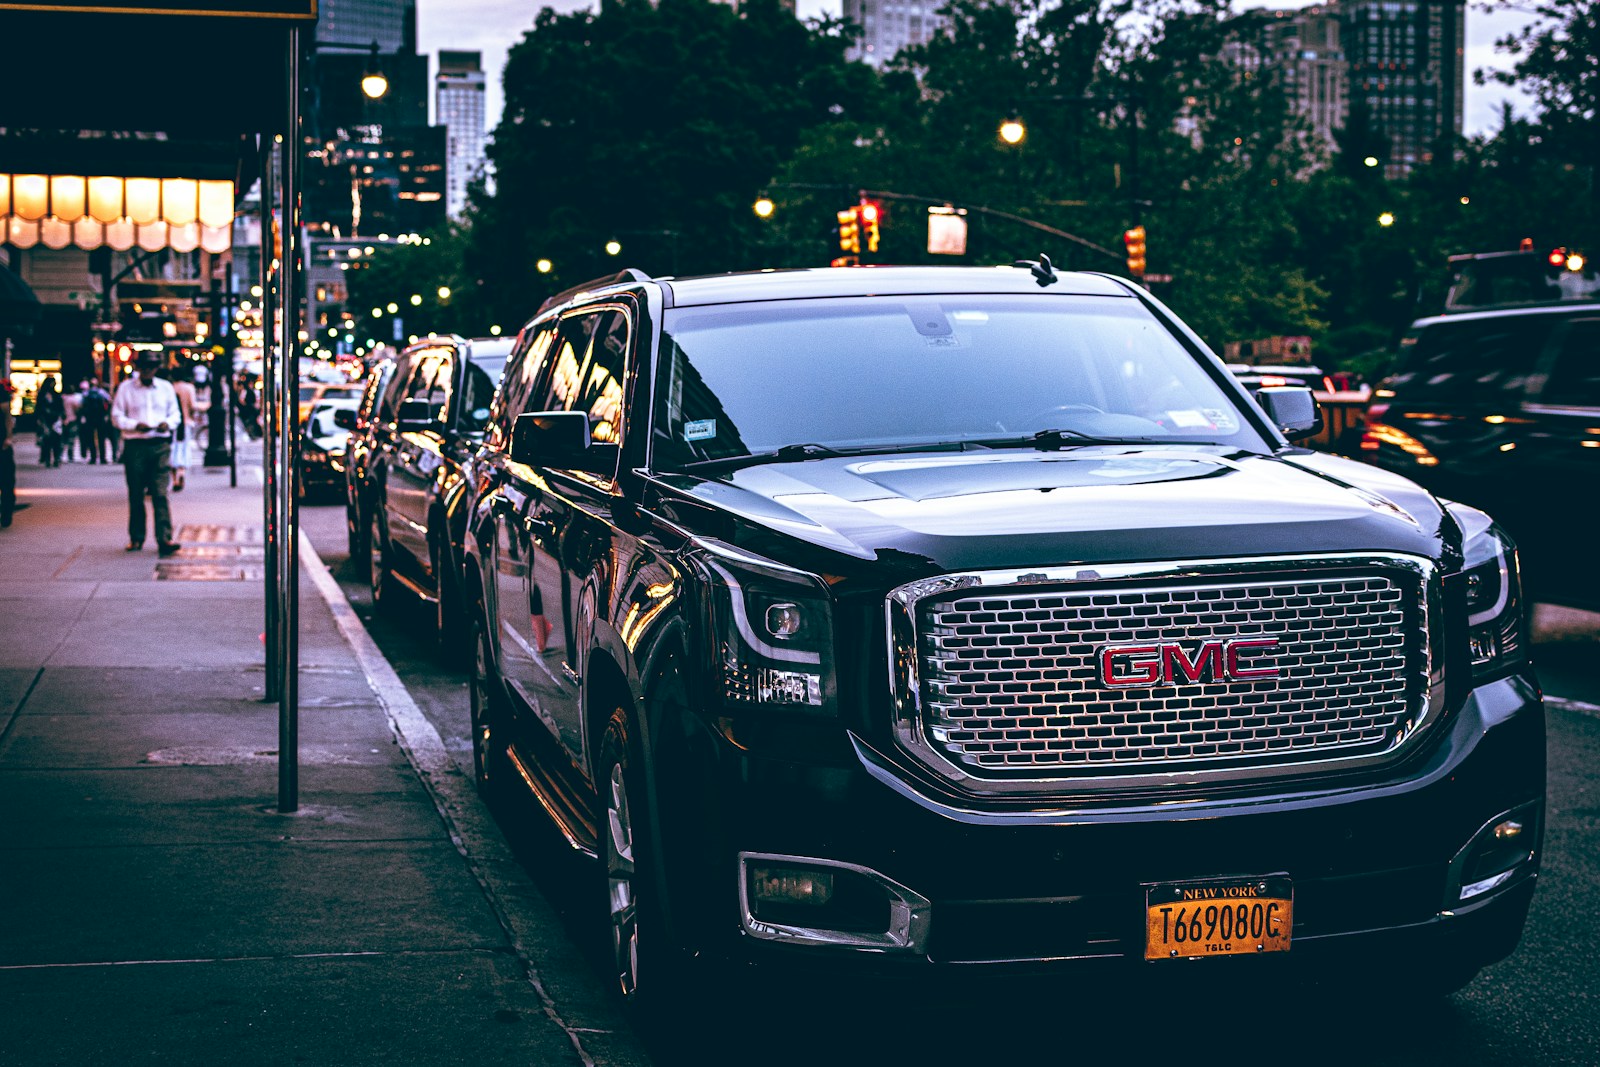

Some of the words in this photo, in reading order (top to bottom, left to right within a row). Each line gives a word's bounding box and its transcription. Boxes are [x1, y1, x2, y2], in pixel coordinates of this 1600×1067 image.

[1100, 637, 1280, 689] GMC
[1184, 888, 1217, 900] NEW
[1222, 886, 1258, 897] YORK
[1160, 903, 1280, 944] T669080C
[1205, 943, 1232, 952] T&LC
